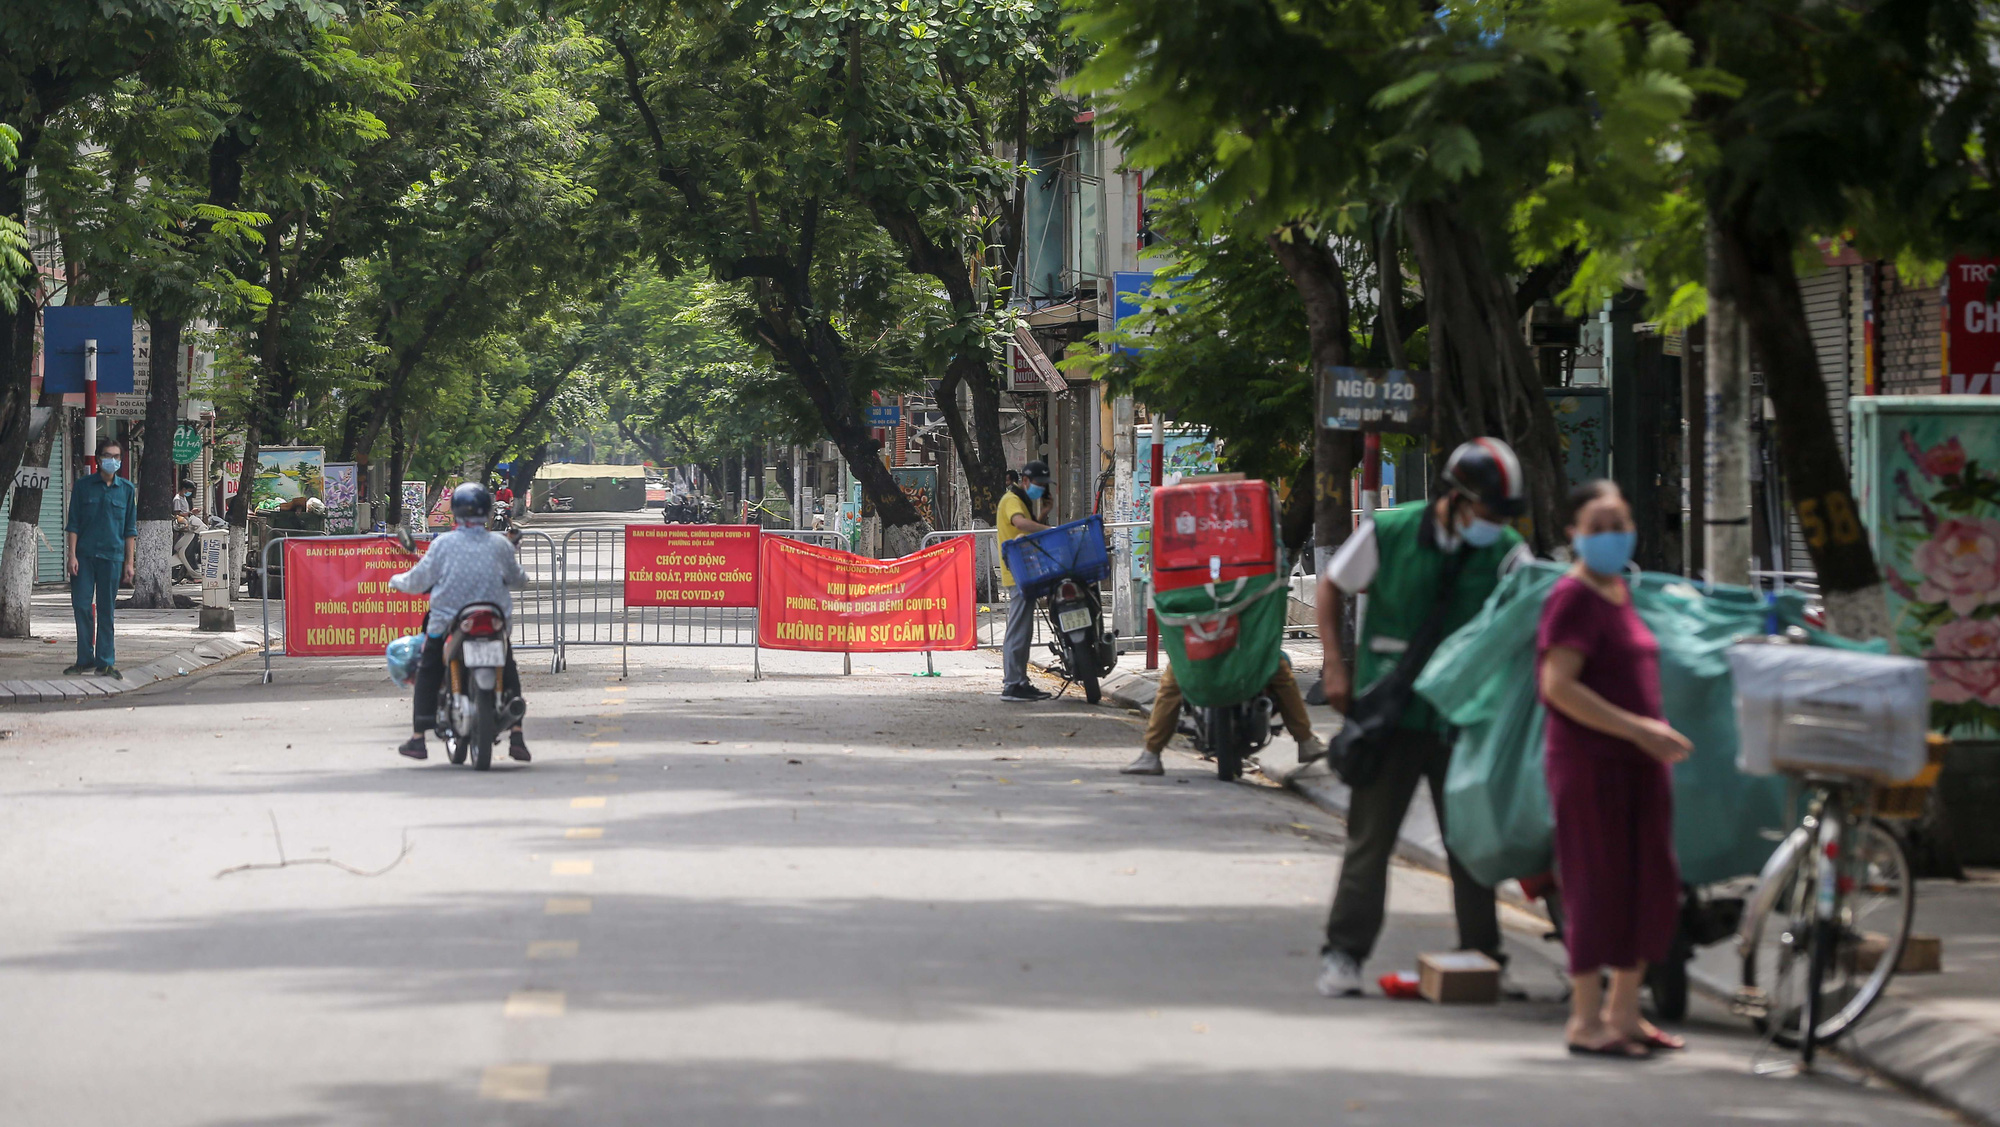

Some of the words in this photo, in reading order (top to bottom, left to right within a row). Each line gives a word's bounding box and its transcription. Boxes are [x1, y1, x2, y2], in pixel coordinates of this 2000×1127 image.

[1382, 382, 1415, 401] 120
[120, 408, 138, 416] 0984
[1198, 516, 1249, 533] Shopee
[306, 548, 322, 556] BAN
[324, 546, 337, 555] CHỈ
[338, 548, 355, 558] ĐẠO
[356, 546, 383, 555] PHÒNG
[656, 551, 682, 565] CHỐT
[683, 554, 698, 565] CƠ
[698, 553, 726, 568] ĐỘNG
[365, 559, 397, 569] PHƯỜNG
[398, 559, 412, 571] ĐỘI
[629, 566, 653, 581] KIỂM
[655, 569, 682, 583] SOÁT,
[684, 569, 717, 581] PHÒNG
[719, 567, 753, 582] CHỐNG
[357, 581, 377, 594] KHU
[656, 589, 680, 602] DỊCH
[827, 582, 845, 595] KHU
[848, 582, 866, 597] VỰC
[868, 582, 893, 595] CÁCH
[895, 582, 906, 594] LY
[315, 599, 350, 615] PHÒNG,
[352, 597, 385, 614] CHỐNG
[386, 600, 409, 615] DỊCH
[786, 594, 819, 611] PHÒNG,
[821, 597, 853, 612] CHỐNG
[855, 601, 877, 615] DỊCH
[879, 599, 904, 614] BỆNH
[905, 597, 947, 610] COVID-19
[306, 624, 356, 646] KHÔNG
[776, 620, 824, 641] KHÔNG
[827, 622, 866, 645] PHẬN
[870, 624, 891, 645] SỰ
[893, 619, 924, 641] CẤM
[928, 621, 956, 640] VÀO
